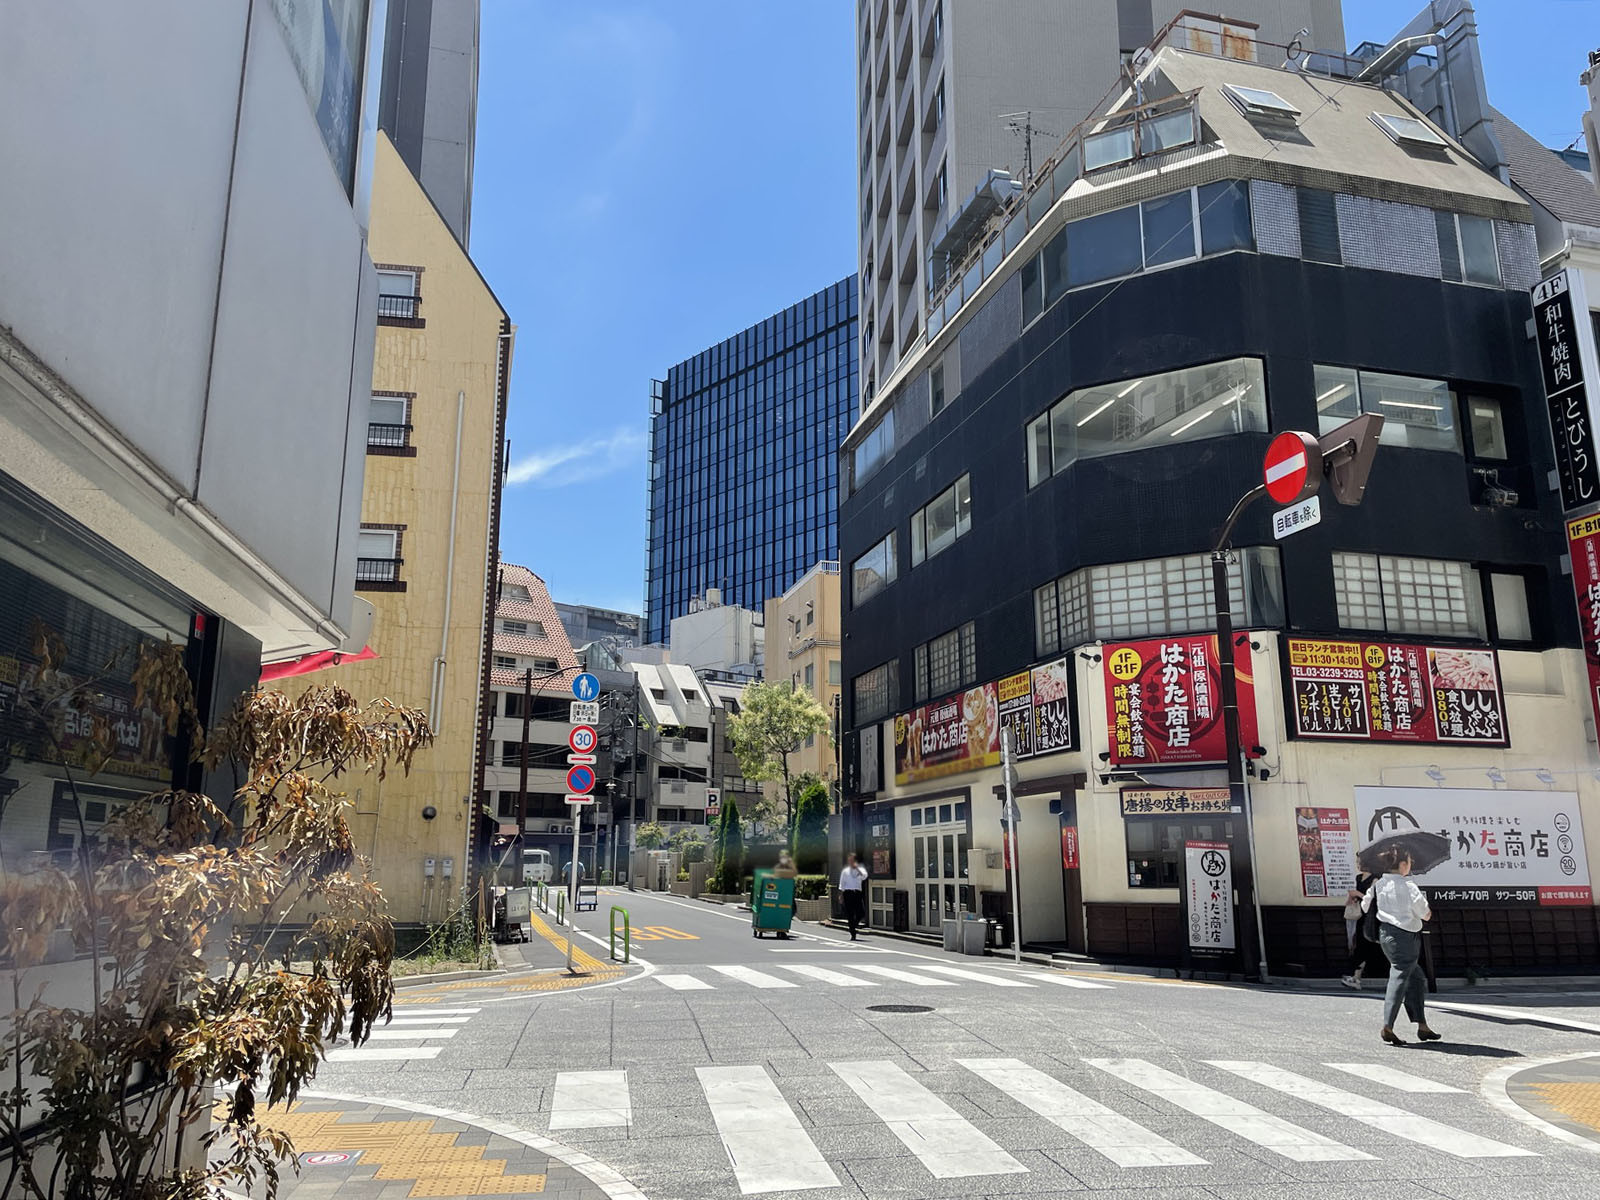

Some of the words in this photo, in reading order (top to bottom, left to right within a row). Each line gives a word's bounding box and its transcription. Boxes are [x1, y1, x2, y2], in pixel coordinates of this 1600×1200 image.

[1537, 277, 1561, 300] 4F
[1544, 303, 1571, 384] 和牛焼肉
[1566, 397, 1593, 499] とびうし
[1277, 505, 1317, 532] 自転車を除く
[1114, 663, 1137, 674] B1F
[1118, 653, 1131, 663] 1F
[1191, 643, 1206, 667] 元祖
[1368, 656, 1382, 664] B1F
[1370, 648, 1378, 656] 1F
[1291, 667, 1364, 679] TEL.03-3239-3293
[1387, 646, 1411, 730] はかた商店
[1160, 643, 1191, 747] はかた商店
[1306, 683, 1322, 731] ハイボール
[1328, 683, 1344, 731] 生ビール
[1348, 685, 1361, 728] サワー
[1113, 684, 1132, 758] 時間無制限
[1128, 683, 1145, 757] 宴会飲み放題
[1446, 690, 1464, 737] 食べ放題
[576, 733, 591, 746] 30
[922, 719, 968, 755] はかた商店
[709, 794, 717, 806] P
[1209, 879, 1221, 943] はかた商店
[1435, 891, 1489, 901] ハイボール70円
[1496, 891, 1536, 901] サワー50円
